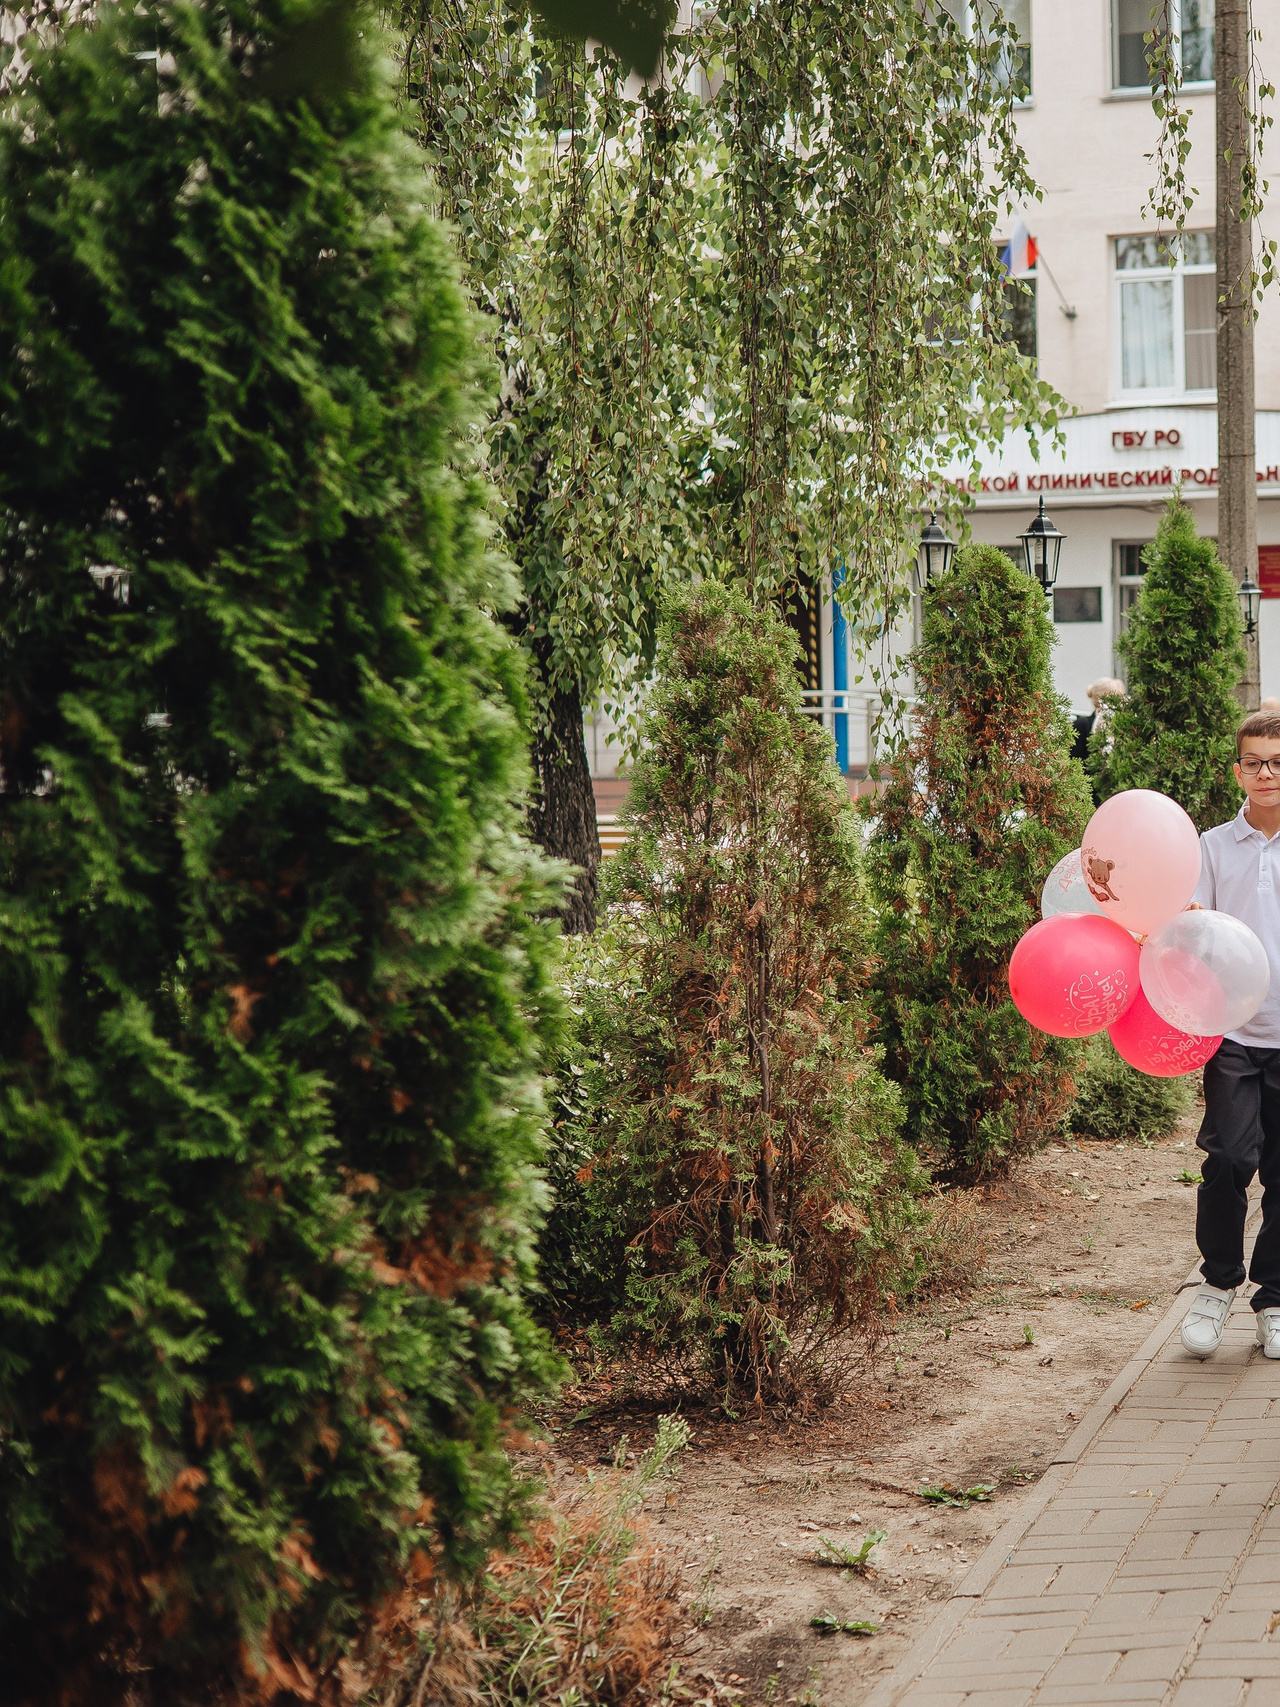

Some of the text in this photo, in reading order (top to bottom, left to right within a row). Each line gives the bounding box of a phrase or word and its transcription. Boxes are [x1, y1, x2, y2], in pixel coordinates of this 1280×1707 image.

[1112, 429, 1180, 446] ГБУ РО
[1027, 466, 1172, 490] КЛИНИЧЕСКИЙ
